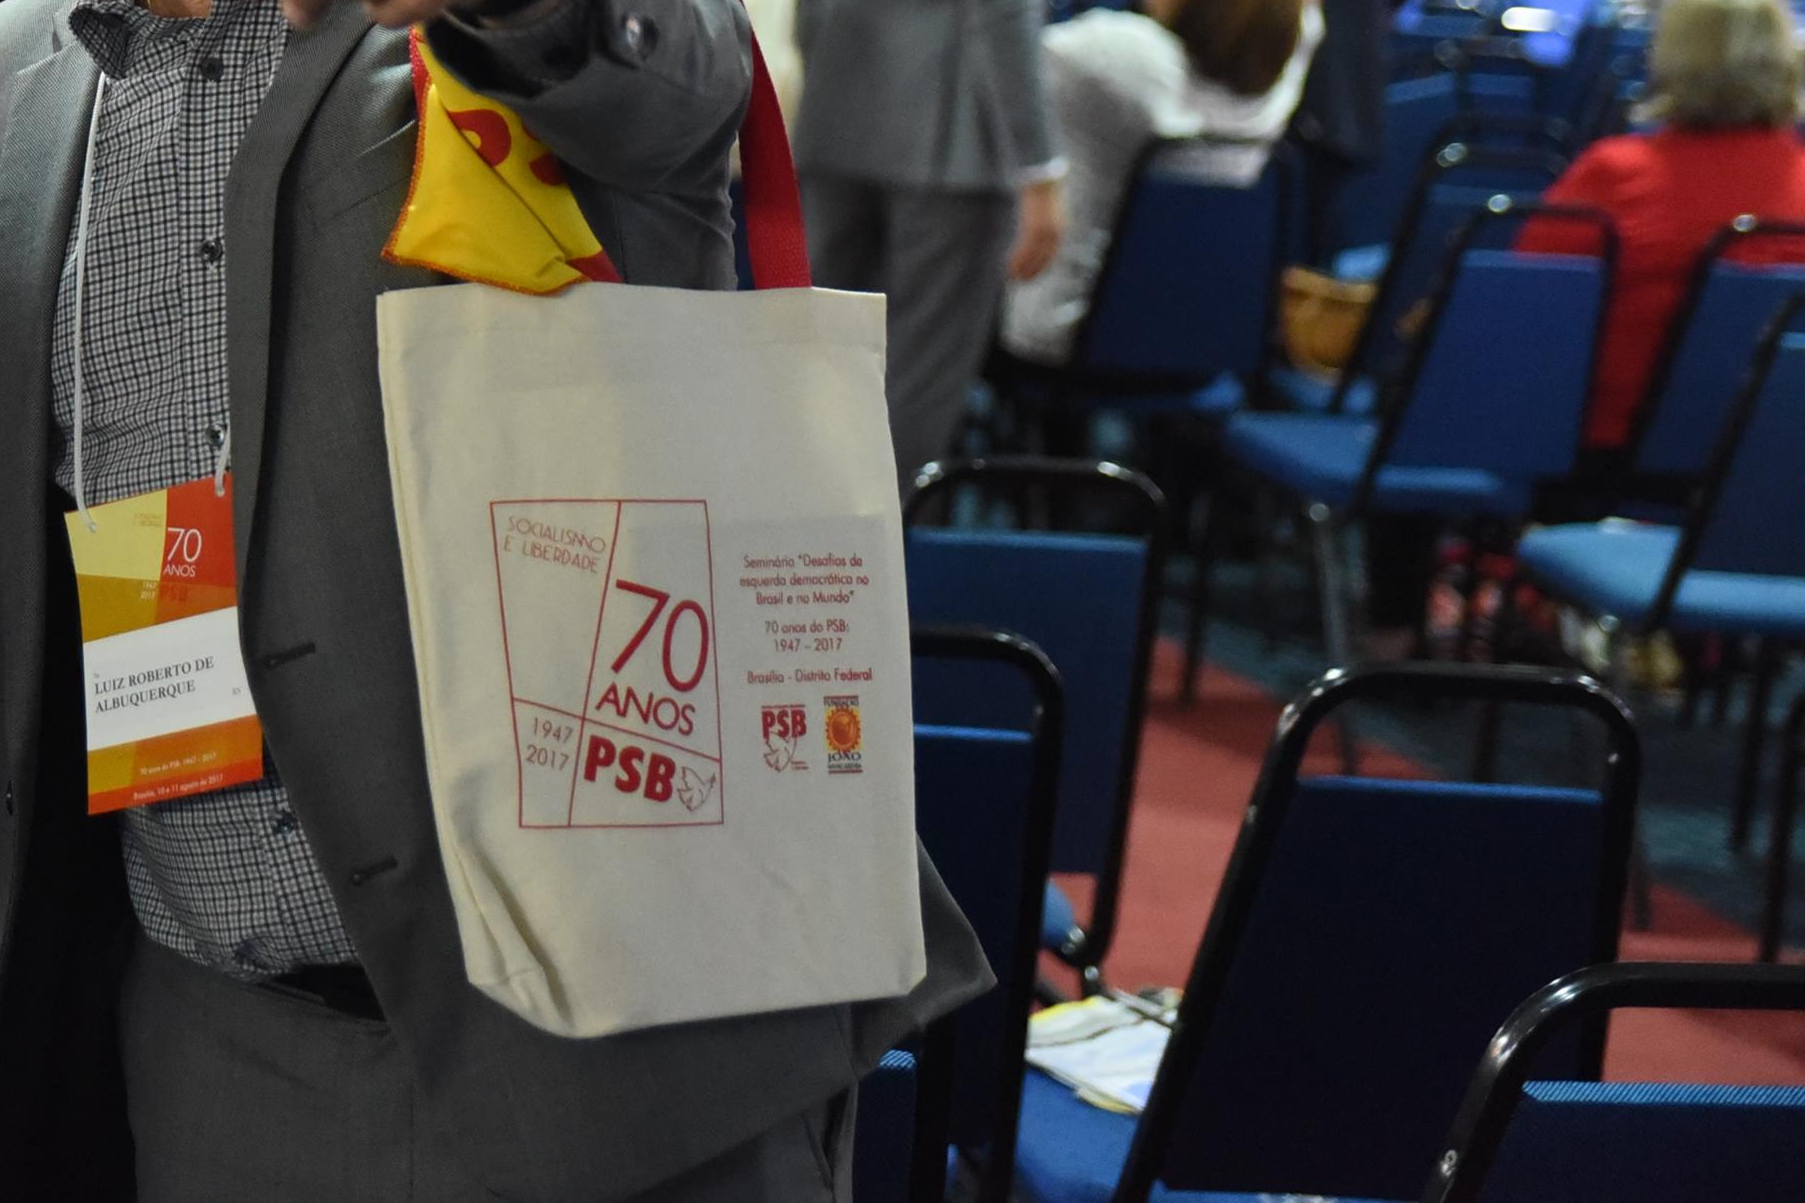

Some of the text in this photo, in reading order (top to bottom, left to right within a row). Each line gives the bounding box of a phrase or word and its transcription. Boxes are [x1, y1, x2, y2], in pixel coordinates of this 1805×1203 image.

[167, 527, 202, 562] 70
[508, 515, 606, 553] SOCIALISMO
[503, 534, 601, 573] E LIBERDADE
[743, 554, 795, 568] Seminário
[163, 564, 196, 577] ANOS
[739, 572, 869, 589] esquerda democrática no
[756, 591, 784, 605] Brasil
[787, 595, 793, 605] e
[796, 594, 810, 604] no
[610, 578, 709, 692] 70
[765, 620, 779, 634] 70
[781, 623, 806, 633] anos
[810, 620, 823, 633] do
[774, 638, 801, 652] 1947
[814, 637, 843, 652] 2017
[95, 656, 215, 695] LUIZ ROBERTO DE
[795, 668, 831, 682] Distrito
[834, 667, 873, 681] Federal
[95, 680, 196, 713] ALBUQUERQUE
[595, 681, 696, 736] ANOS
[533, 716, 573, 744] 1947
[761, 708, 807, 742] PSB
[525, 744, 570, 771] 2017
[584, 734, 676, 802] PSB
